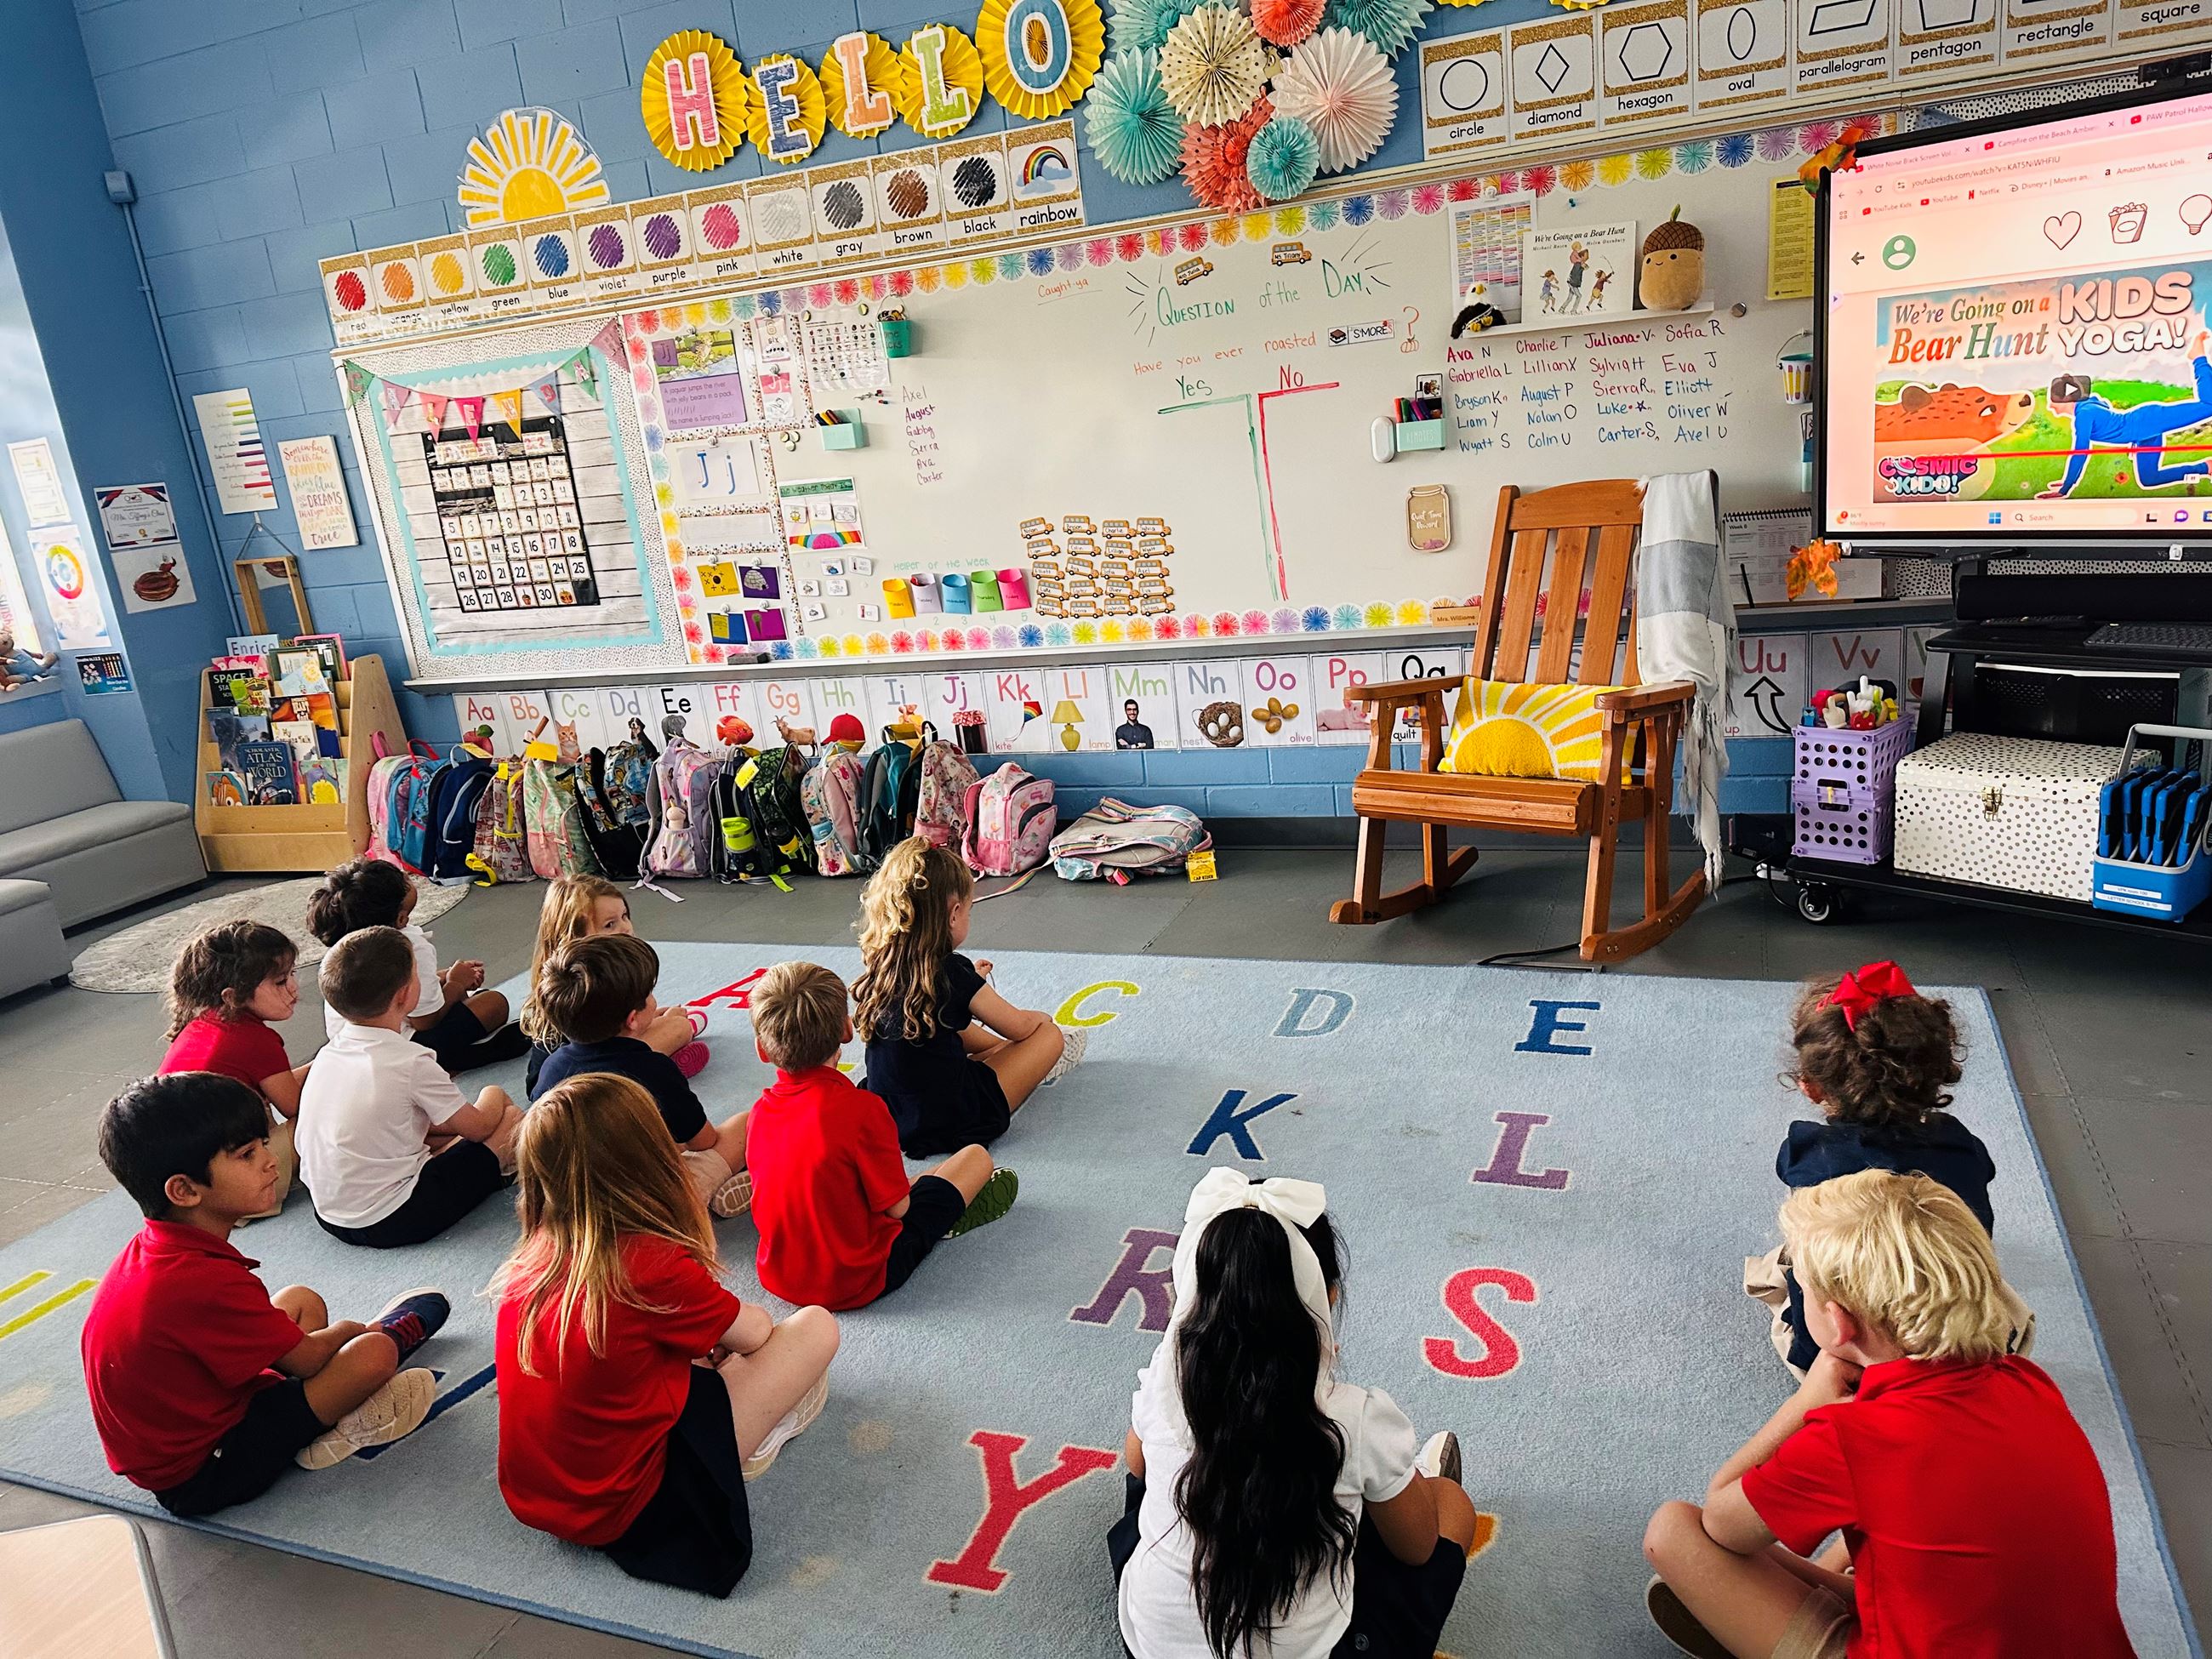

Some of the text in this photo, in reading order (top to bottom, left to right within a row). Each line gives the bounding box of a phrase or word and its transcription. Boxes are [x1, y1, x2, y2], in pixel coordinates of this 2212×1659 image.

[2141, 3, 2200, 24] square
[2017, 18, 2094, 43] rectangle
[1910, 38, 1981, 63] pentagon
[1799, 54, 1886, 78] parallelogram
[664, 0, 1073, 157] HELLO
[1728, 77, 1754, 92] oval
[1617, 91, 1673, 111] hexagon
[1527, 105, 1582, 126] diamond
[1450, 123, 1484, 139] circle
[2051, 129, 2071, 138] Beach
[1933, 194, 1958, 204] YouTube
[1020, 205, 1077, 227] rainbow
[1873, 204, 1898, 214] YouTube
[963, 216, 996, 234] black
[1590, 229, 1606, 237] Bear
[894, 228, 932, 244] brown
[772, 250, 803, 264] white
[835, 240, 864, 257] gray
[653, 267, 686, 285] purple
[716, 260, 738, 276] pink
[549, 287, 568, 299] blue
[599, 277, 626, 291] violet
[492, 295, 520, 311] green
[1259, 282, 1272, 308] of
[1276, 281, 1300, 302] the
[2058, 271, 2193, 324] KIDS
[441, 302, 470, 316] yellow
[1895, 296, 2050, 326] We're Going on a
[351, 321, 367, 332] red
[1666, 319, 1725, 342] Sofia R
[1889, 322, 2049, 364] Bear Hunt
[2057, 317, 2187, 357] YOGA!
[1133, 359, 1163, 375] Have
[1177, 354, 1201, 369] you
[1215, 347, 1243, 360] ever
[1264, 332, 1316, 353] roasted
[1446, 346, 1474, 363] Ava
[1516, 339, 1559, 355] Charlie
[1662, 353, 1696, 373] Eva
[1280, 364, 1303, 388] No
[1448, 367, 1502, 384] Gabriella
[903, 385, 926, 402] Axel
[1176, 375, 1212, 399] Yes
[1521, 385, 1561, 403] August
[1593, 381, 1639, 396] Sierra
[905, 404, 935, 423] August
[1527, 411, 1562, 426] Nolan
[1668, 404, 1711, 419] Oliver
[1457, 415, 1487, 430] Liam
[1459, 437, 1494, 455] Wyatt
[1528, 431, 1558, 448] Colin
[916, 459, 935, 470] Ava
[307, 492, 342, 507] DREAMS
[520, 488, 547, 500] 2 3
[506, 516, 533, 528] 8 9
[2028, 512, 2054, 522] Search
[453, 536, 576, 556] 12 15 18
[966, 557, 990, 567] Week
[459, 562, 584, 582] 19 20 21 22 24 25
[464, 589, 552, 606] 26 28 30
[1740, 639, 1787, 674] Uu
[1832, 636, 1881, 672] Vv
[1115, 668, 1167, 698] Mm
[1188, 664, 1226, 695] Nn
[1256, 662, 1297, 692] Oo
[822, 681, 855, 708] Hh
[943, 676, 966, 711] Jj
[996, 674, 1033, 702] Kk
[510, 695, 539, 721] Bb
[561, 693, 590, 718] Cc
[609, 690, 641, 716] Dd
[663, 687, 692, 715] Ee
[714, 685, 740, 712] Ff
[767, 683, 801, 715] Gg
[467, 697, 495, 721] Aa
[1290, 733, 1312, 743] olive
[1394, 728, 1417, 740] quilt
[1724, 725, 1740, 737] up
[995, 741, 1012, 750] kite
[1089, 739, 1111, 750] lamp
[1183, 738, 1204, 746] nest
[247, 753, 283, 763] ATLAS
[248, 767, 286, 777] WORLD
[1053, 980, 1142, 1028] C
[1273, 987, 1356, 1038] D
[1514, 998, 1603, 1058] E
[1186, 1087, 1300, 1160] K
[1472, 1110, 1571, 1190] L
[1070, 1228, 1179, 1331] R
[1422, 1266, 1537, 1377] S
[926, 1428, 1117, 1591] Y
